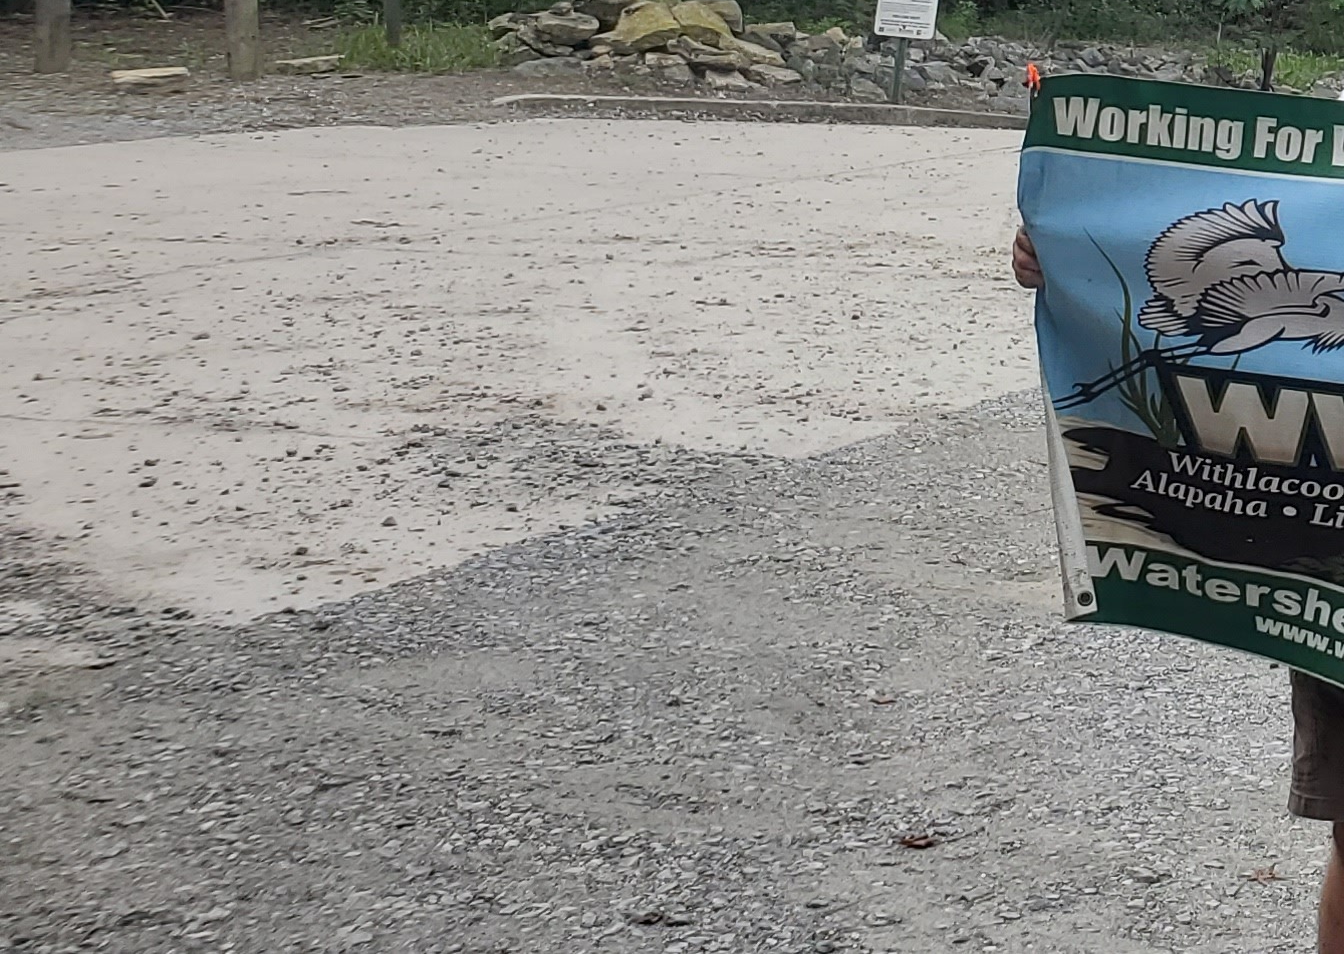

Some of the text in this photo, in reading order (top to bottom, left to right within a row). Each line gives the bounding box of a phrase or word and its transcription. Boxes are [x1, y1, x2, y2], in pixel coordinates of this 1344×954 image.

[1052, 96, 1246, 160] Working
[1252, 115, 1323, 164] For
[1130, 470, 1268, 518] Alapaha
